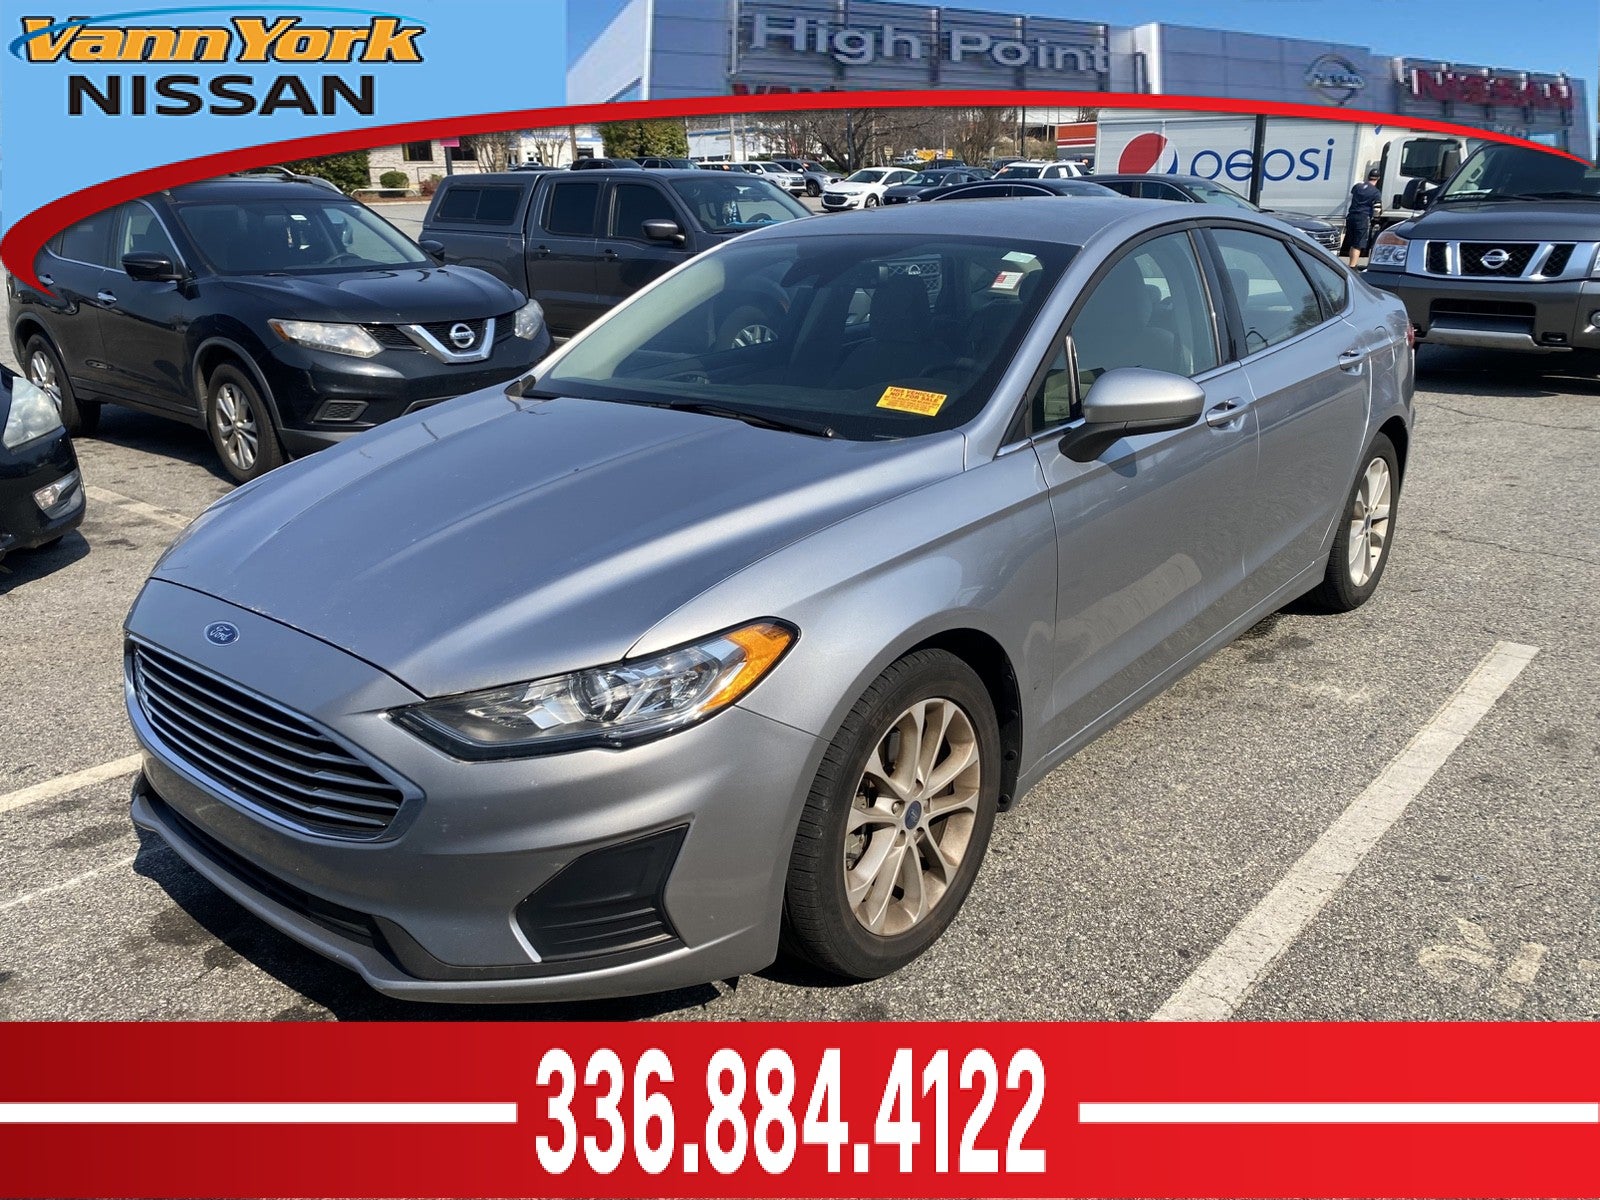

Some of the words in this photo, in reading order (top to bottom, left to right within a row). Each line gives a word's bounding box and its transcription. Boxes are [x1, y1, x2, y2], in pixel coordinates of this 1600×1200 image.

[751, 14, 922, 64] High
[950, 29, 1110, 73] Point
[1190, 138, 1335, 190] pepsi
[907, 390, 936, 398] VEHICLE
[209, 625, 232, 641] Ford
